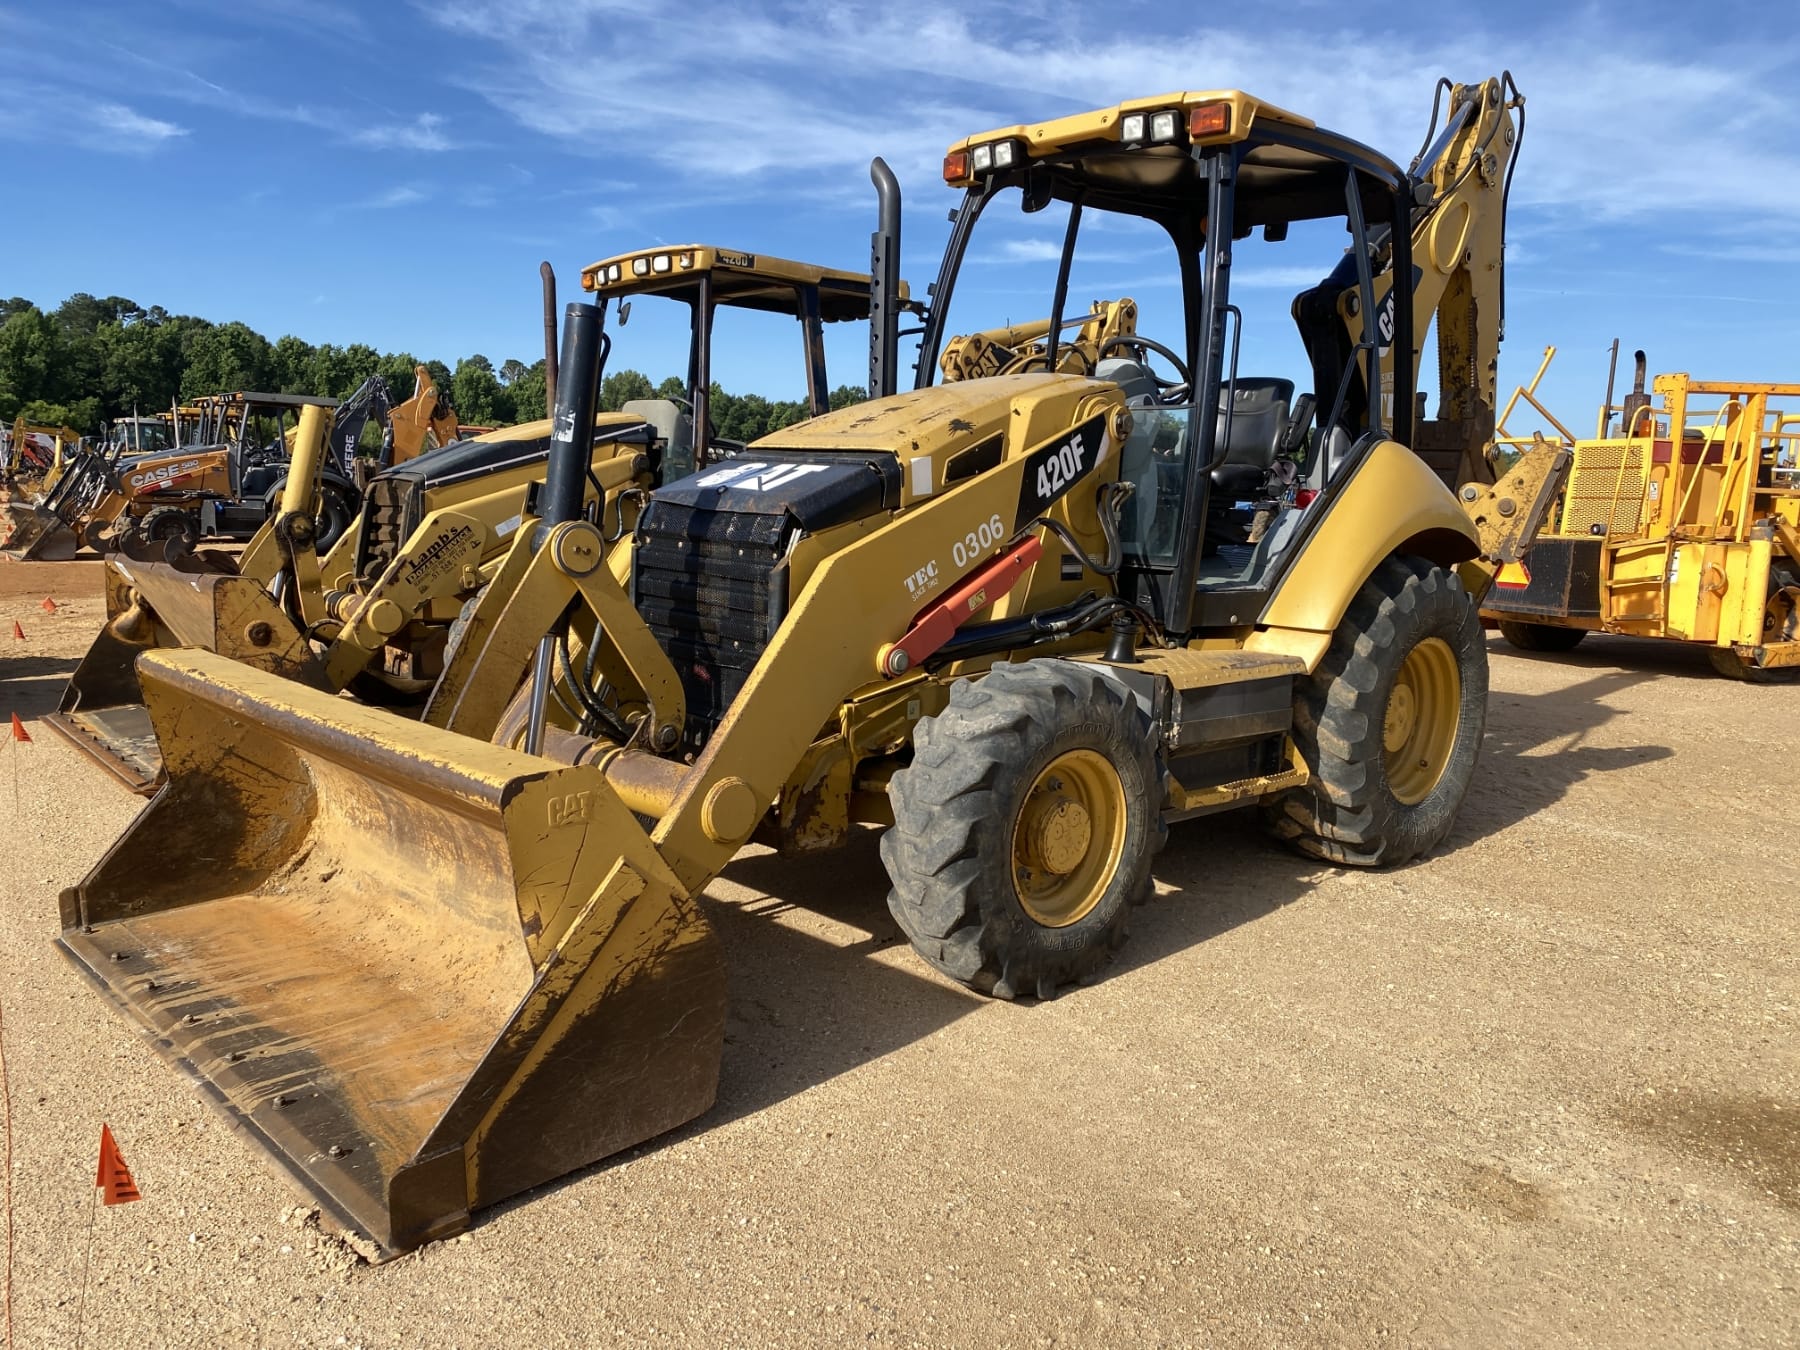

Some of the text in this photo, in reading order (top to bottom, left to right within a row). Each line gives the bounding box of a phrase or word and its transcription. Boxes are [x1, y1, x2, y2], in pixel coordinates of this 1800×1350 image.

[1378, 290, 1395, 342] CA
[130, 463, 180, 487] CASE
[1036, 432, 1085, 499] 420F
[407, 526, 458, 570] Lamb's
[952, 513, 1004, 568] 0306
[903, 559, 939, 593] TEC
[547, 790, 591, 827] CAT
